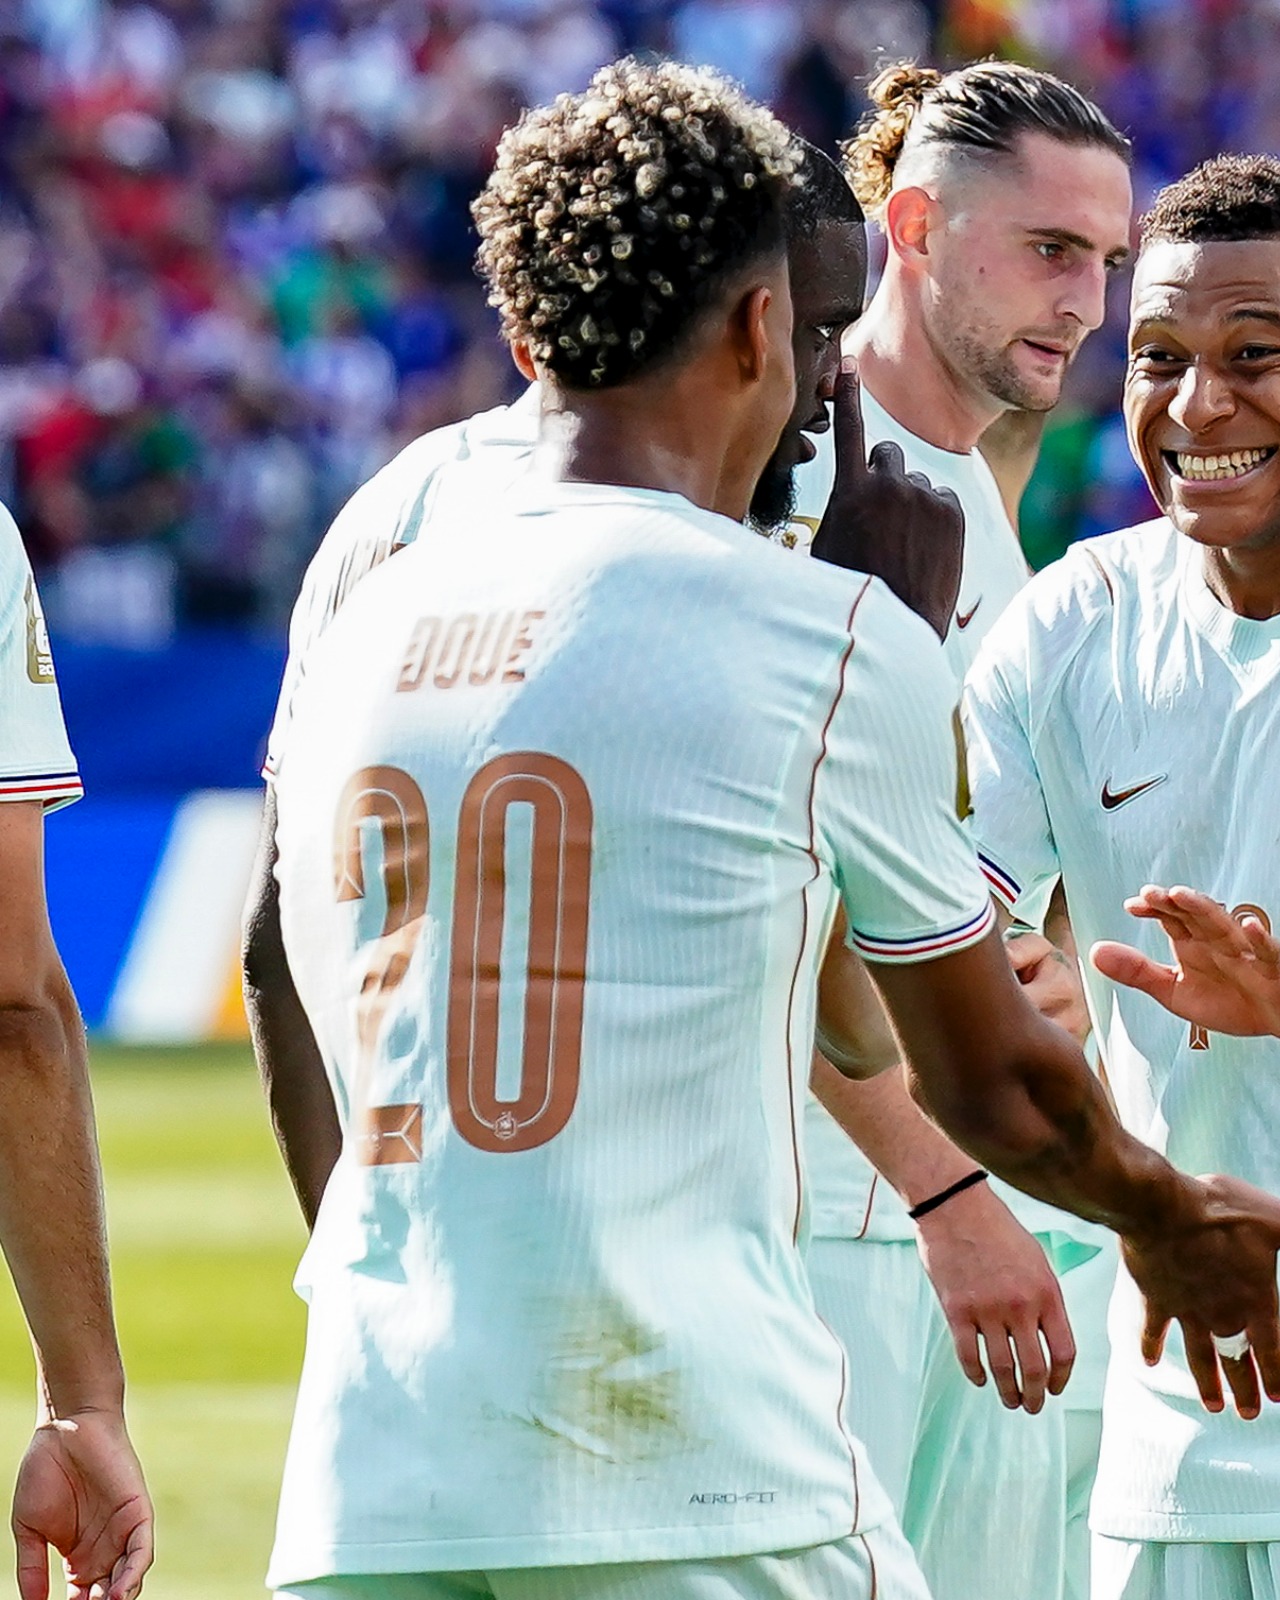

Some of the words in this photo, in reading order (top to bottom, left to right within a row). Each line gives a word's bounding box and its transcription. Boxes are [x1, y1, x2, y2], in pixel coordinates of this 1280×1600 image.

[396, 610, 546, 692] DOUE
[332, 750, 594, 1167] 20
[688, 1491, 778, 1504] AERO-FIT
